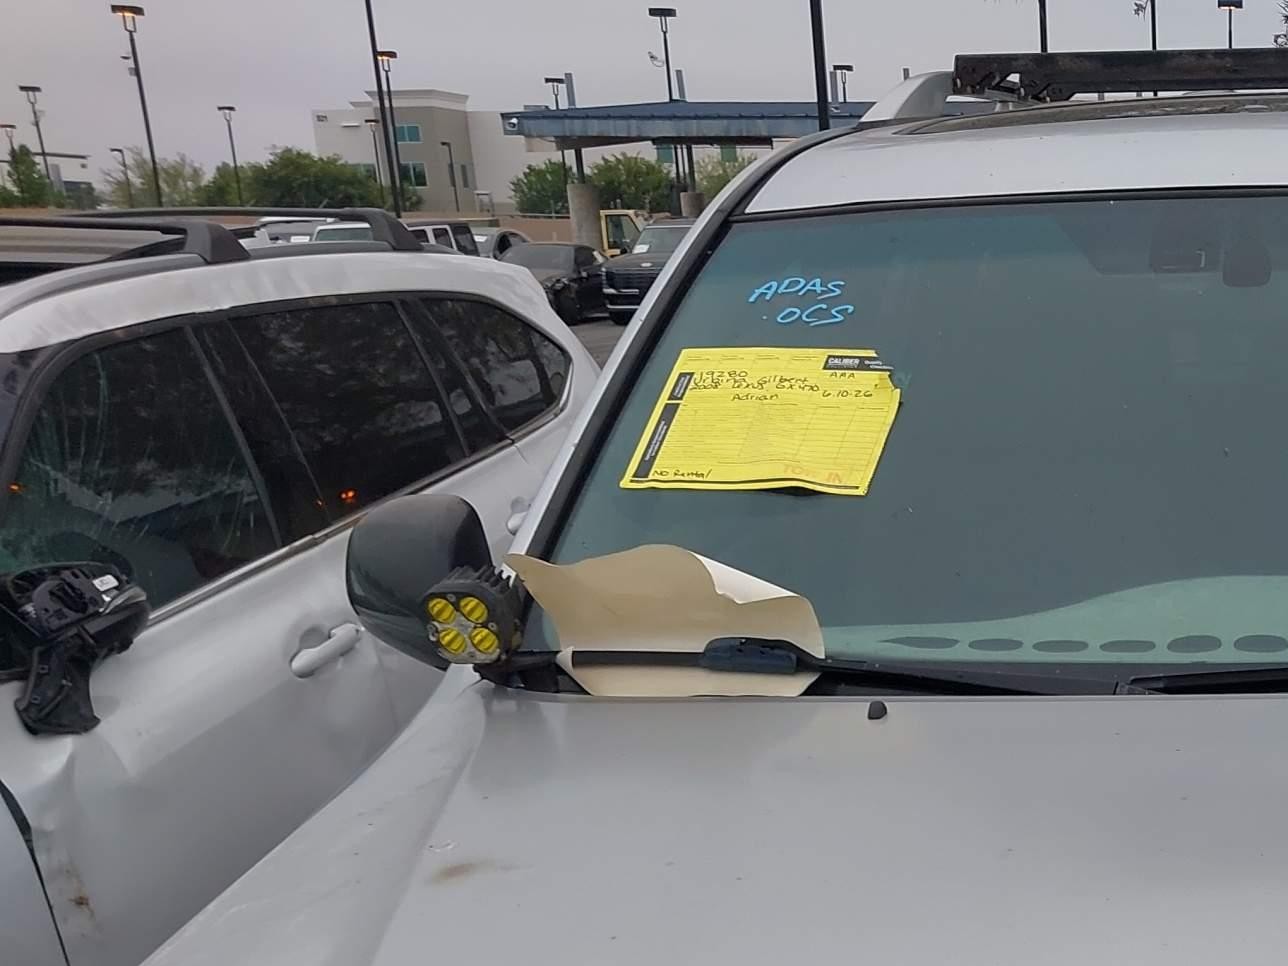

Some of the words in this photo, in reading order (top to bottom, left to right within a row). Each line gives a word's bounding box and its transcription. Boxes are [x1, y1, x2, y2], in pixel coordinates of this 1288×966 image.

[748, 277, 845, 302] ADAS
[776, 303, 855, 326] OCS
[731, 393, 779, 401] Adrian
